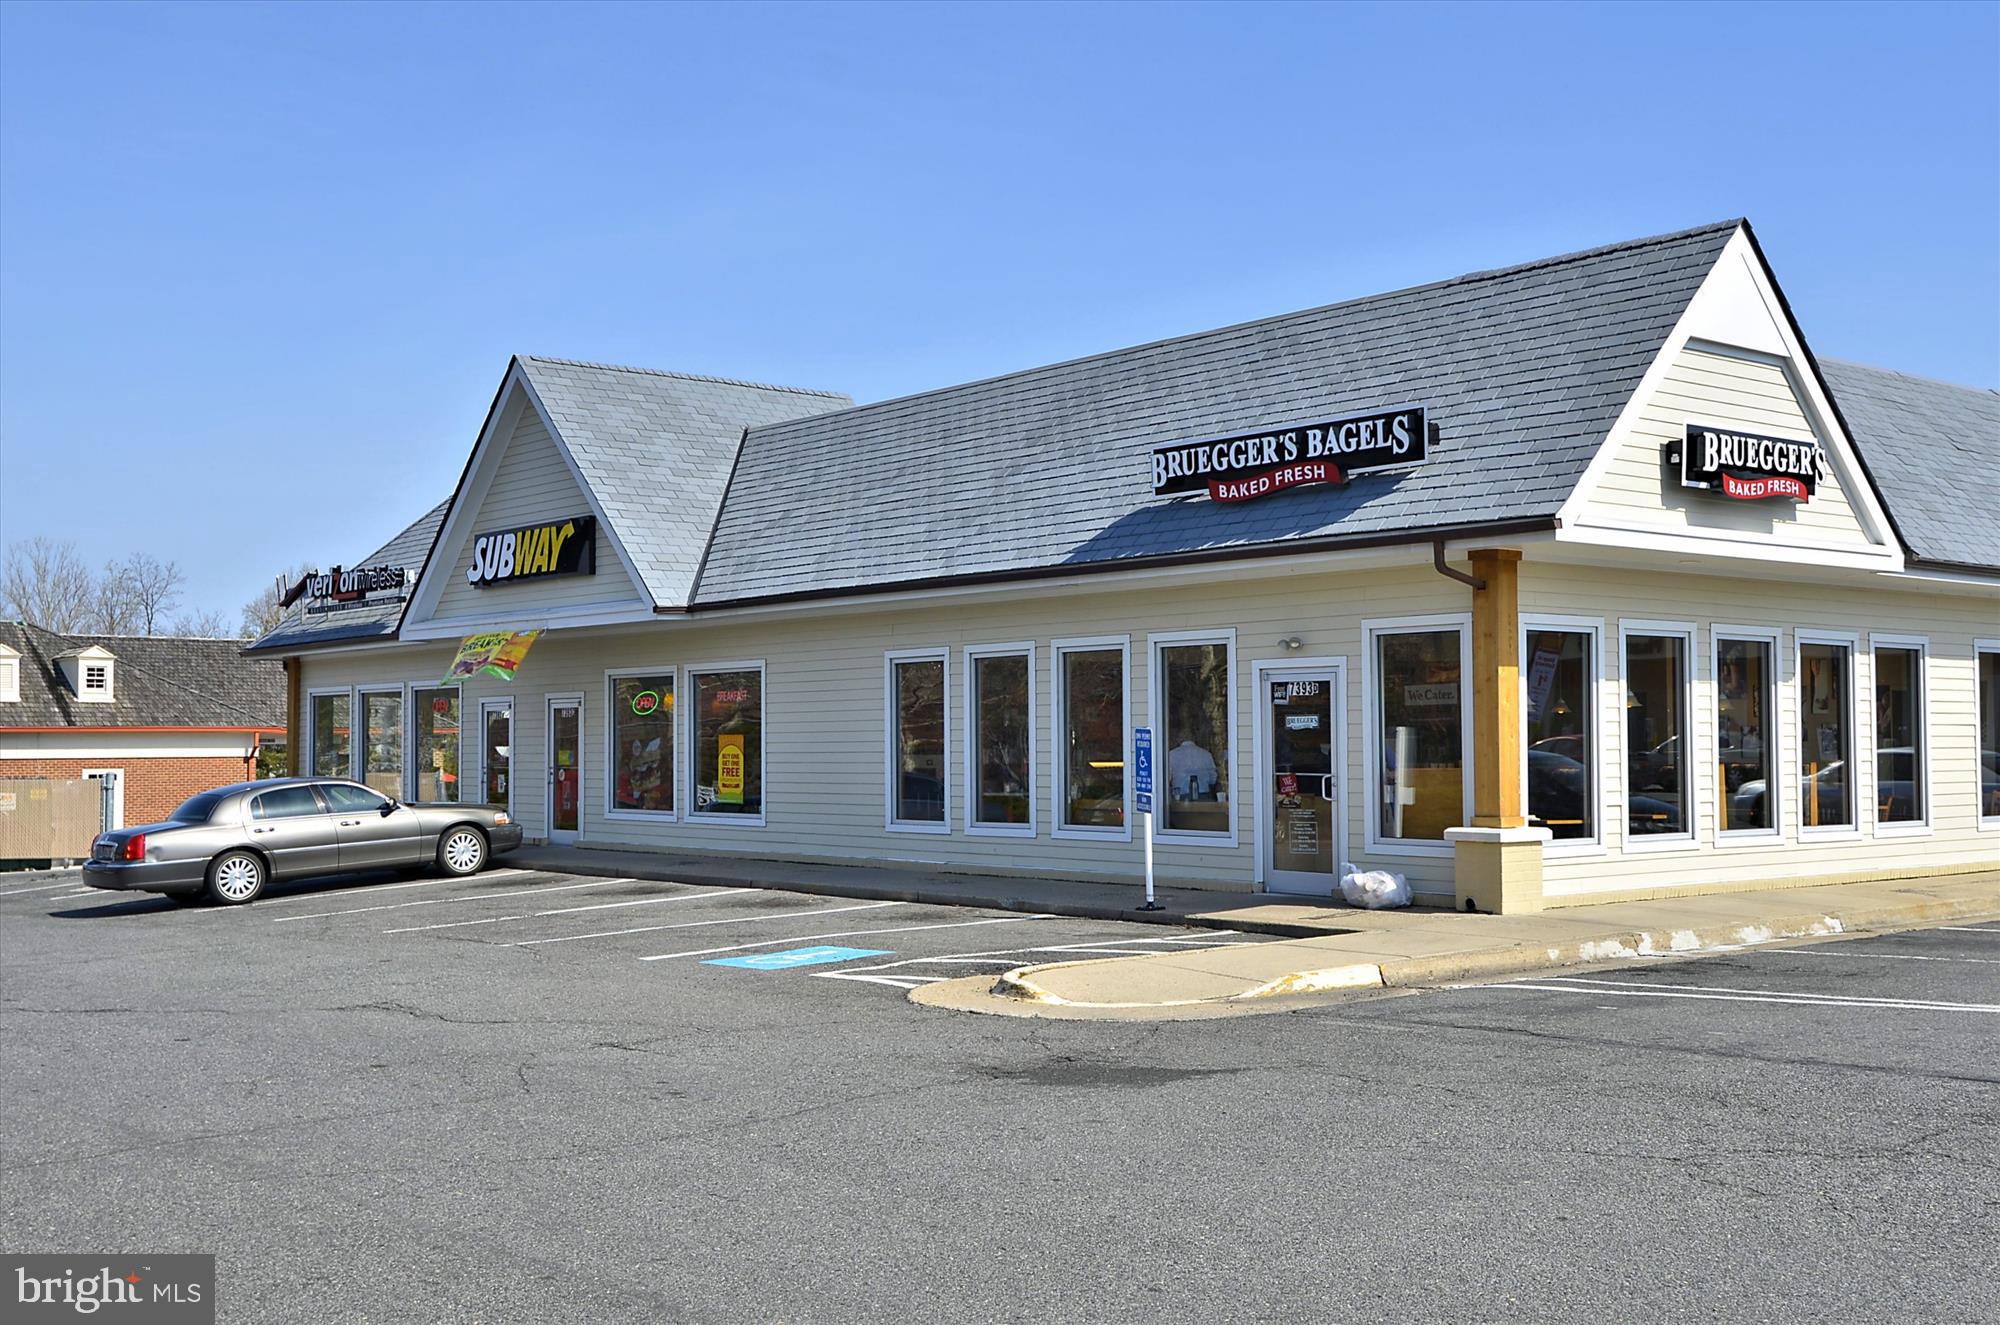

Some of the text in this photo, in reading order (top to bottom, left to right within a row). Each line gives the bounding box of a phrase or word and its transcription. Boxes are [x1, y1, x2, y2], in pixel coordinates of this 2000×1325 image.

[1151, 414, 1410, 488] BRUEGGER'S BAGELS
[1703, 432, 1827, 486] BRUEGGER'S
[1218, 465, 1325, 499] BAKED FRESH
[1729, 480, 1799, 496] BAKED FRESH
[467, 520, 575, 584] SUBWAY
[637, 695, 655, 709] OPEN
[1408, 689, 1424, 701] We
[722, 767, 740, 777] FREE
